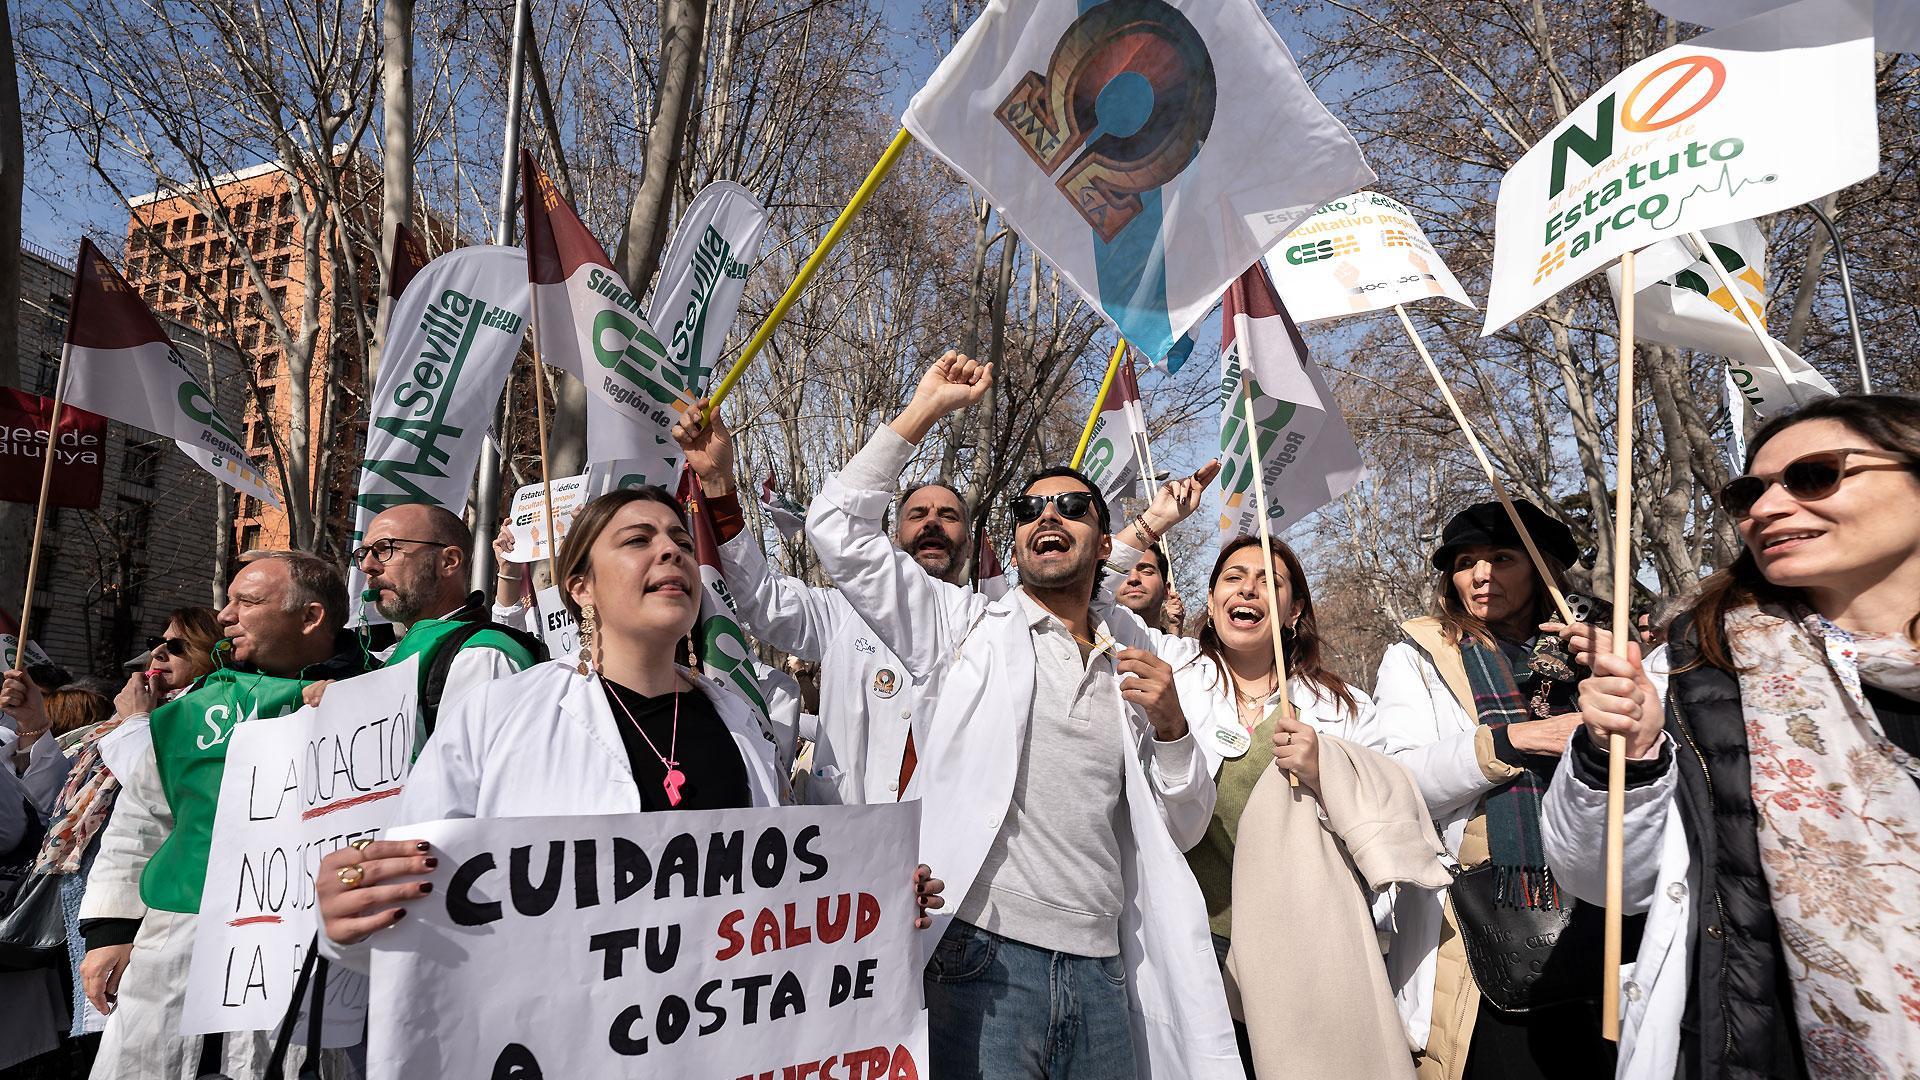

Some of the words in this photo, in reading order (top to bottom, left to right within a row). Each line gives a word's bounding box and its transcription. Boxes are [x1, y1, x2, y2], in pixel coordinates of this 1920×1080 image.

[1545, 137, 1745, 247] Estatuto
[1568, 137, 1657, 198] borrador
[672, 223, 723, 360] Sevilla
[393, 289, 473, 418] Sevilla
[603, 375, 651, 415] Región
[650, 410, 670, 427] de
[61, 429, 98, 446] de
[520, 490, 546, 501] Estatut
[249, 757, 299, 822] LA
[236, 846, 288, 913] NO
[445, 824, 829, 928] CUIDAMOS
[589, 923, 681, 981] TU
[715, 892, 881, 961] SALUD
[222, 944, 268, 1008] LA
[608, 970, 806, 1057] COSTA
[829, 958, 878, 1008] DE
